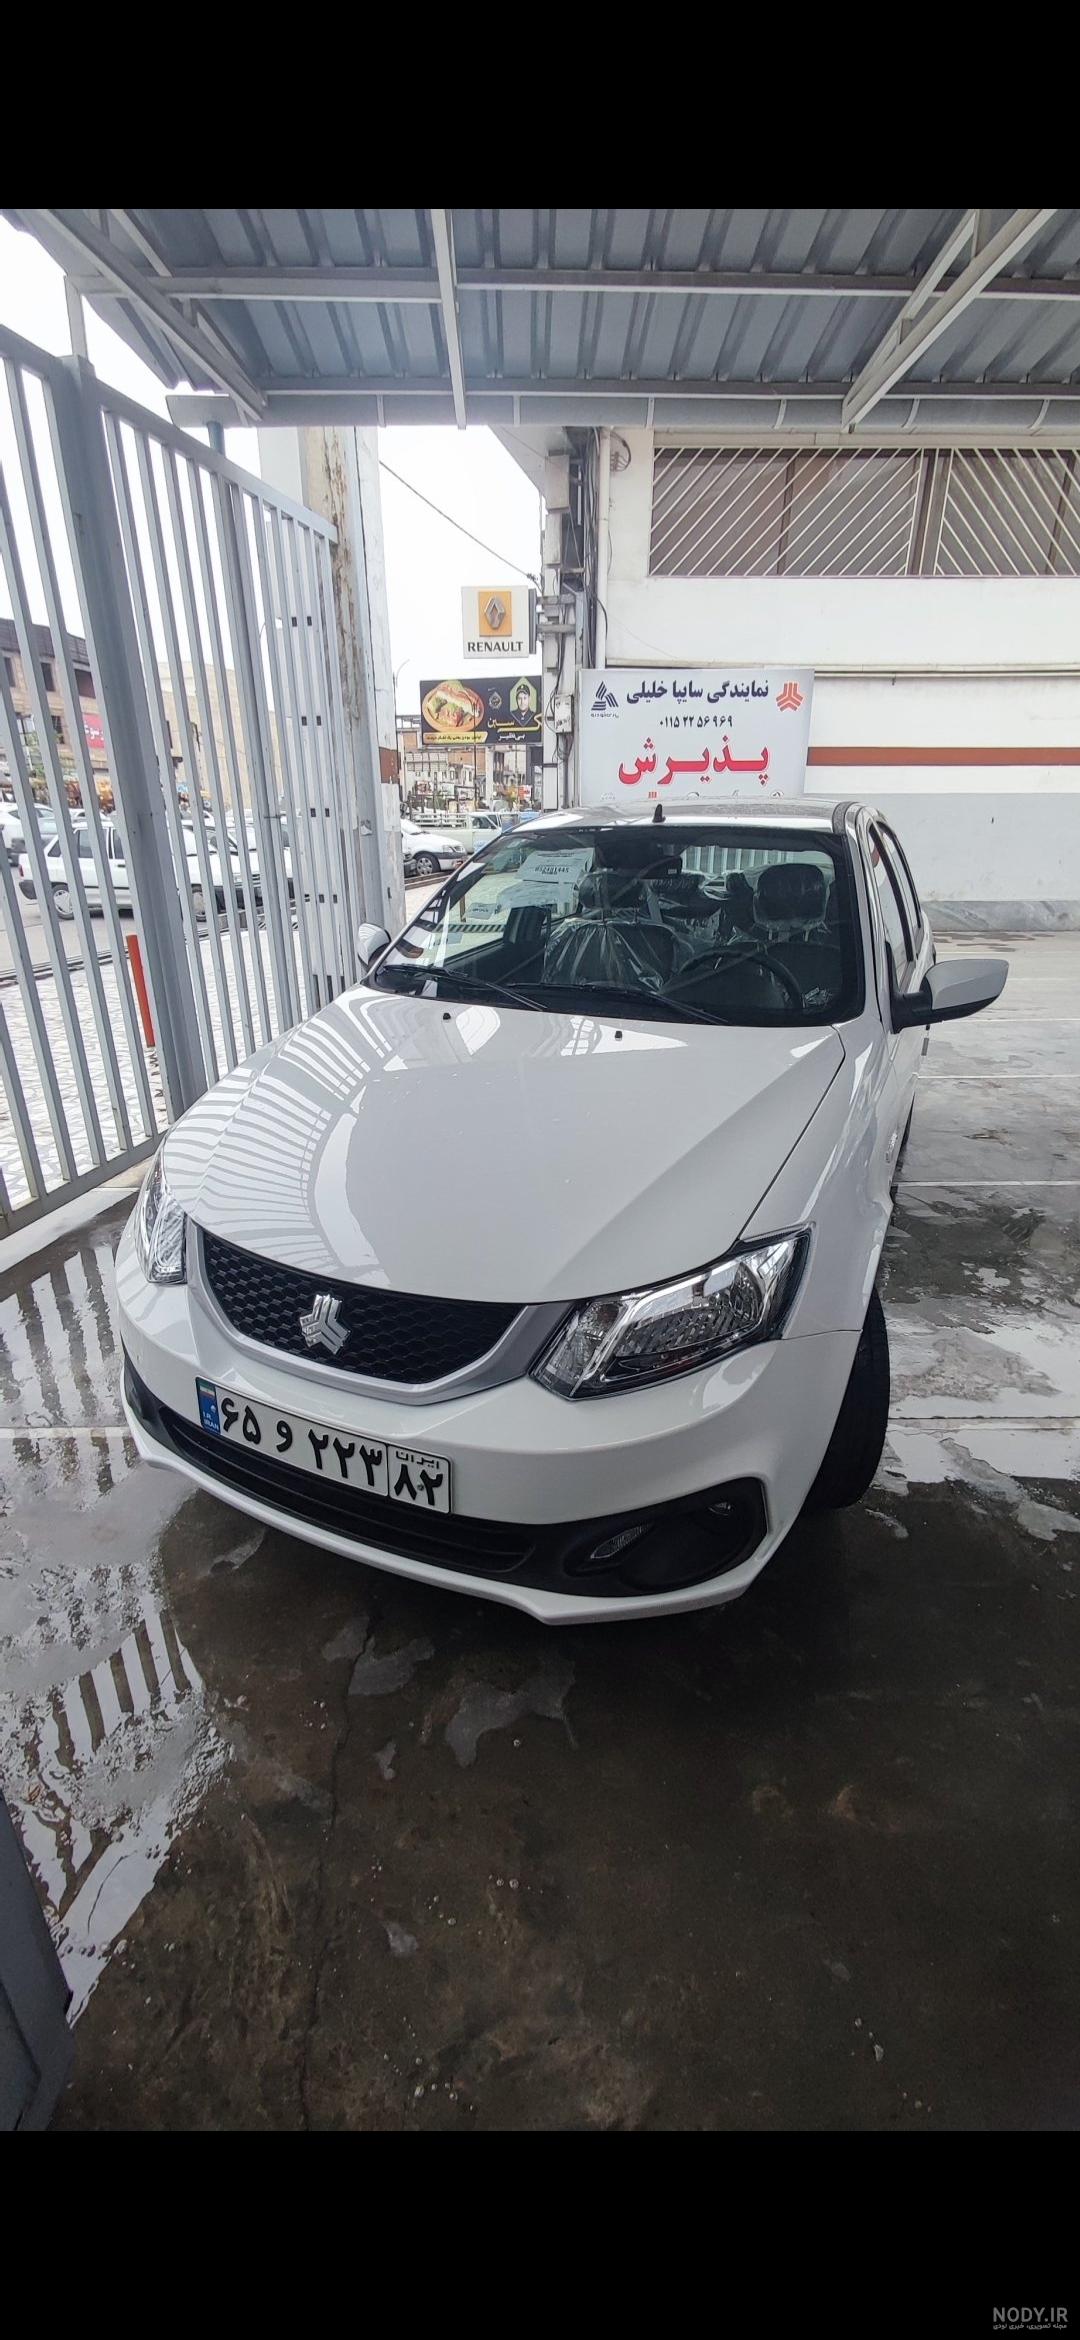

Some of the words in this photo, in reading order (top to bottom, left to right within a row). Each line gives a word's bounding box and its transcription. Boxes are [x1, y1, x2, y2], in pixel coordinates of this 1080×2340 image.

[467, 641, 523, 652] RENAULT
[626, 680, 668, 704] خلیلی
[672, 680, 704, 704] سایپا
[707, 680, 769, 704] نمایندگی
[659, 715, 680, 728] ۰۱۱۵
[683, 715, 694, 728] ۲۲
[697, 715, 710, 728] ۵۶
[713, 715, 733, 728] ۹۶۹
[618, 735, 769, 786] پذیرش
[203, 1418, 219, 1431] IRAN
[221, 1398, 261, 1445] ۶۵
[276, 1420, 293, 1453] و
[308, 1429, 382, 1487] ۲۲۳
[396, 1450, 439, 1469] ایران
[394, 1463, 443, 1506] ۸۲
